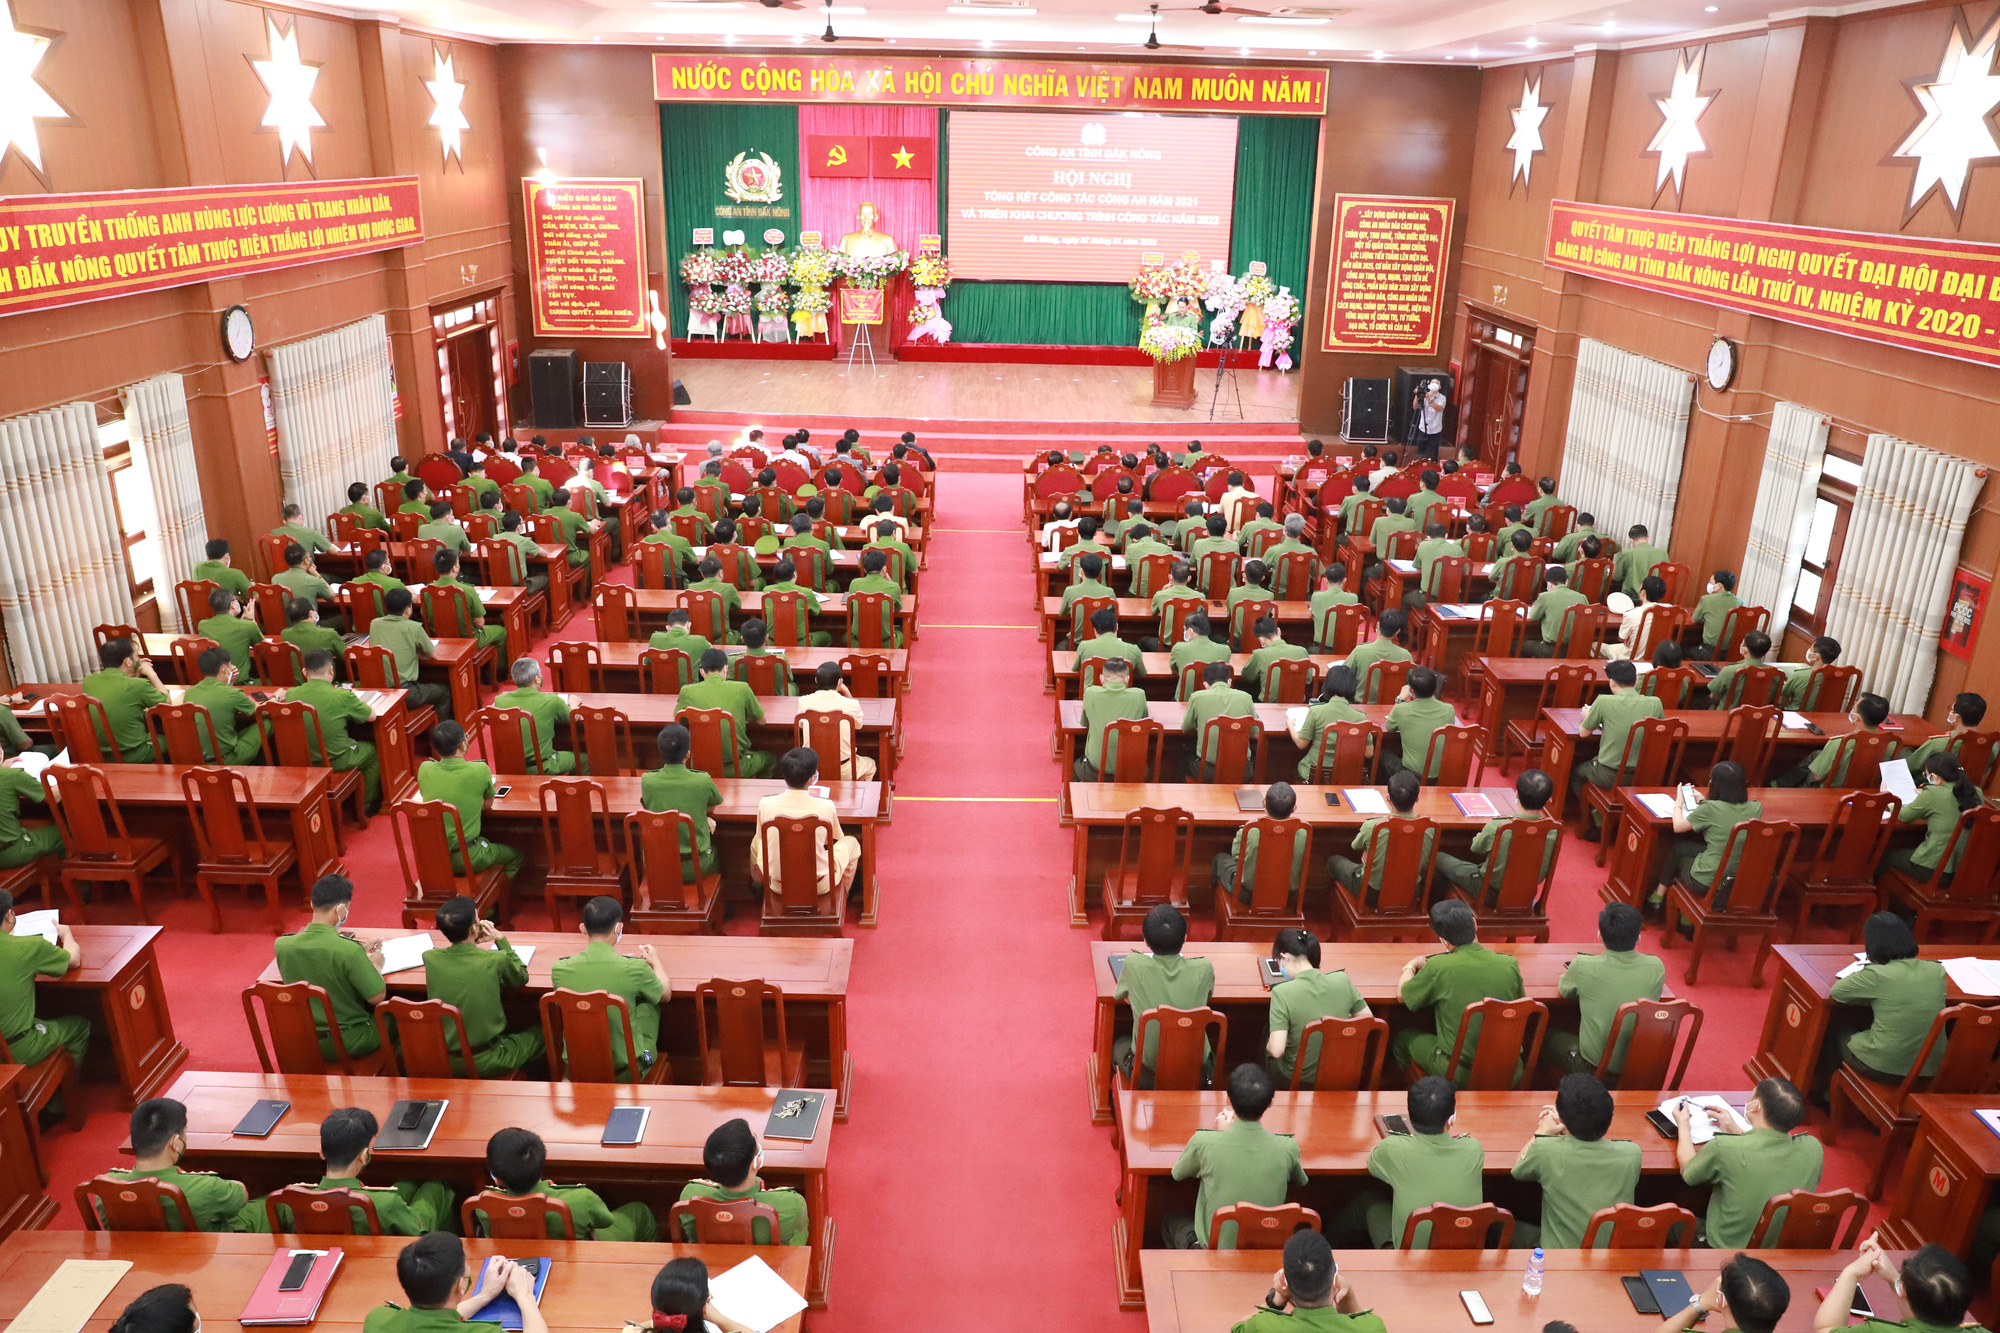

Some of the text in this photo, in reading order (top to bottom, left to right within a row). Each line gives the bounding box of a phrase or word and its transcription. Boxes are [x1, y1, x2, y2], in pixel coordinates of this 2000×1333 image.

[671, 60, 731, 90] NƯỚC
[740, 62, 802, 95] CỘNG
[866, 65, 896, 93] XÃ
[905, 65, 941, 98] HỘI
[1003, 68, 1068, 97] NGHĨA
[1076, 70, 1124, 103] VIỆT
[1134, 76, 1182, 100] NAM
[1191, 72, 1254, 102] MUÔN
[1025, 145, 1058, 157] CÔNG
[1060, 147, 1075, 158] AN
[1129, 148, 1162, 160] NÔNG
[1053, 169, 1133, 189] HỘI NGHỊ
[1040, 191, 1072, 203] CÔNG
[1073, 192, 1095, 204] TÁC
[1097, 192, 1129, 204] CÔNG
[1131, 195, 1147, 205] AN
[1149, 194, 1173, 206] NĂM
[1175, 196, 1198, 207] 2021
[24, 214, 103, 249] TRUYỀN
[104, 210, 161, 241] THỐNG
[162, 211, 193, 235] ANH
[194, 206, 232, 231] HÙNG
[233, 204, 257, 230] LỰC
[257, 202, 295, 226] LƯỢNG
[295, 199, 311, 221] VŨ
[312, 199, 346, 219] TRANG
[346, 195, 371, 216] NHÂN
[372, 193, 392, 212] DÂN,
[960, 207, 976, 218] VÀ
[1010, 210, 1035, 220] KHAI
[1084, 210, 1115, 222] TRÌNH
[1117, 211, 1148, 223] CÔNG
[1149, 212, 1170, 224] TÁC
[1172, 213, 1195, 225] NĂM
[1196, 215, 1219, 225] 2022
[15, 255, 60, 290] ĐẮK
[61, 254, 112, 285] NÔNG
[113, 243, 166, 278] QUYẾT
[167, 241, 201, 267] TÂM
[201, 236, 238, 263] THỰC
[239, 233, 270, 259] HIỆN
[270, 227, 308, 252] THẮNG
[308, 226, 325, 250] LỢI
[325, 223, 358, 245] NHIỆM
[357, 222, 372, 242] VỤ
[371, 218, 395, 239] ĐƯỢC
[395, 216, 416, 234] GIAO.
[1571, 219, 1602, 239] QUYẾT
[1603, 223, 1624, 243] TÂM
[1626, 228, 1655, 251] THỰC
[1656, 231, 1686, 255] HIỆN
[1687, 233, 1731, 260] THẮNG
[1732, 241, 1755, 267] LỢI
[1756, 246, 1796, 275] NGHỊ
[1797, 252, 1858, 280] QUYẾT
[1859, 260, 1896, 290] ĐẠI
[1898, 263, 1938, 296] HỘI
[1940, 270, 1986, 303] ĐẠI
[1555, 238, 1579, 260] ĐẢNG
[1580, 244, 1593, 266] BỘ
[1594, 247, 1621, 269] CÔNG
[1621, 254, 1638, 272] AN
[1639, 253, 1665, 277] TỈNH
[1666, 258, 1692, 283] ĐẮK
[1693, 265, 1730, 290] NÔNG
[1731, 270, 1760, 297] LẦN
[1761, 278, 1795, 303] THỨ
[1793, 285, 1814, 310] IV,
[1817, 291, 1882, 322] NHIỆM
[1883, 298, 1915, 327] KỲ
[1916, 306, 1981, 339] 2020
[1953, 601, 1973, 618] PCCC
[134, 990, 142, 1004] L
[1789, 1008, 1797, 1023] L
[1933, 1170, 1946, 1193] M
